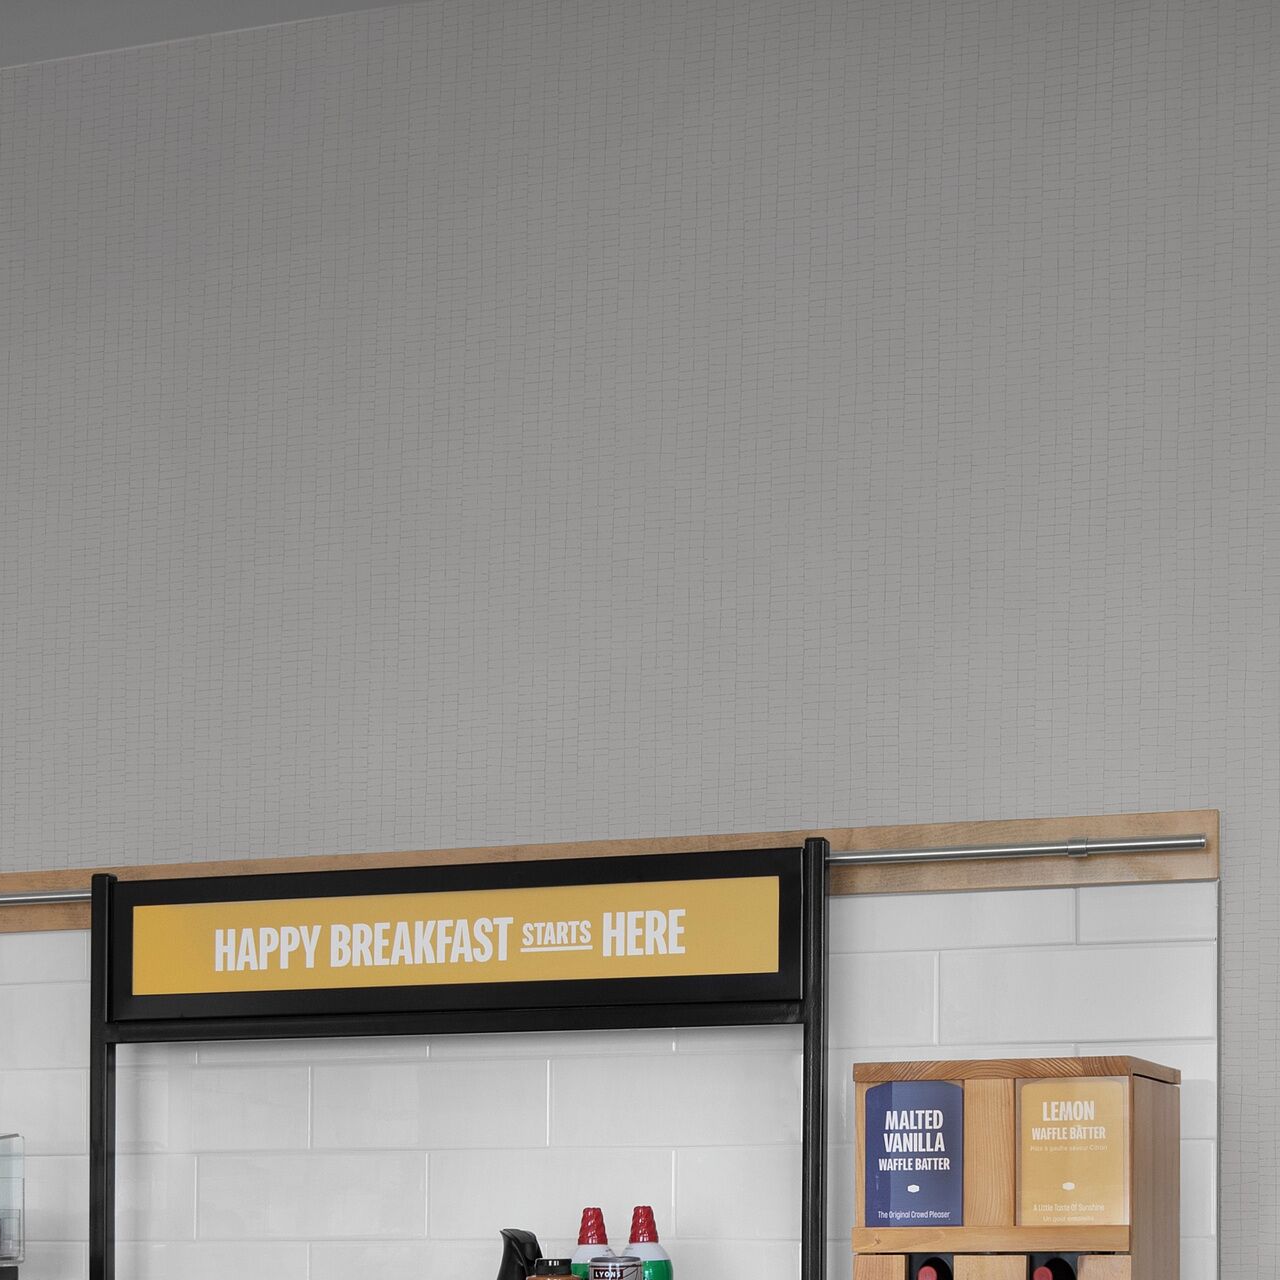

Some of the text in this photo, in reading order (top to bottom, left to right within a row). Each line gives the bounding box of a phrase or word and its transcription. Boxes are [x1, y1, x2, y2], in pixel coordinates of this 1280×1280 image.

[215, 909, 686, 971] HAPPY BREAKFAST STARTS HERE
[885, 1110, 944, 1130] MALTED
[1042, 1101, 1095, 1121] LEMON
[883, 1132, 945, 1152] VANILLA
[1031, 1126, 1106, 1140] WAFFLE BATTER
[878, 1158, 950, 1171] WAFFLE BATTER
[888, 1210, 910, 1220] Original
[910, 1210, 928, 1218] Crowd
